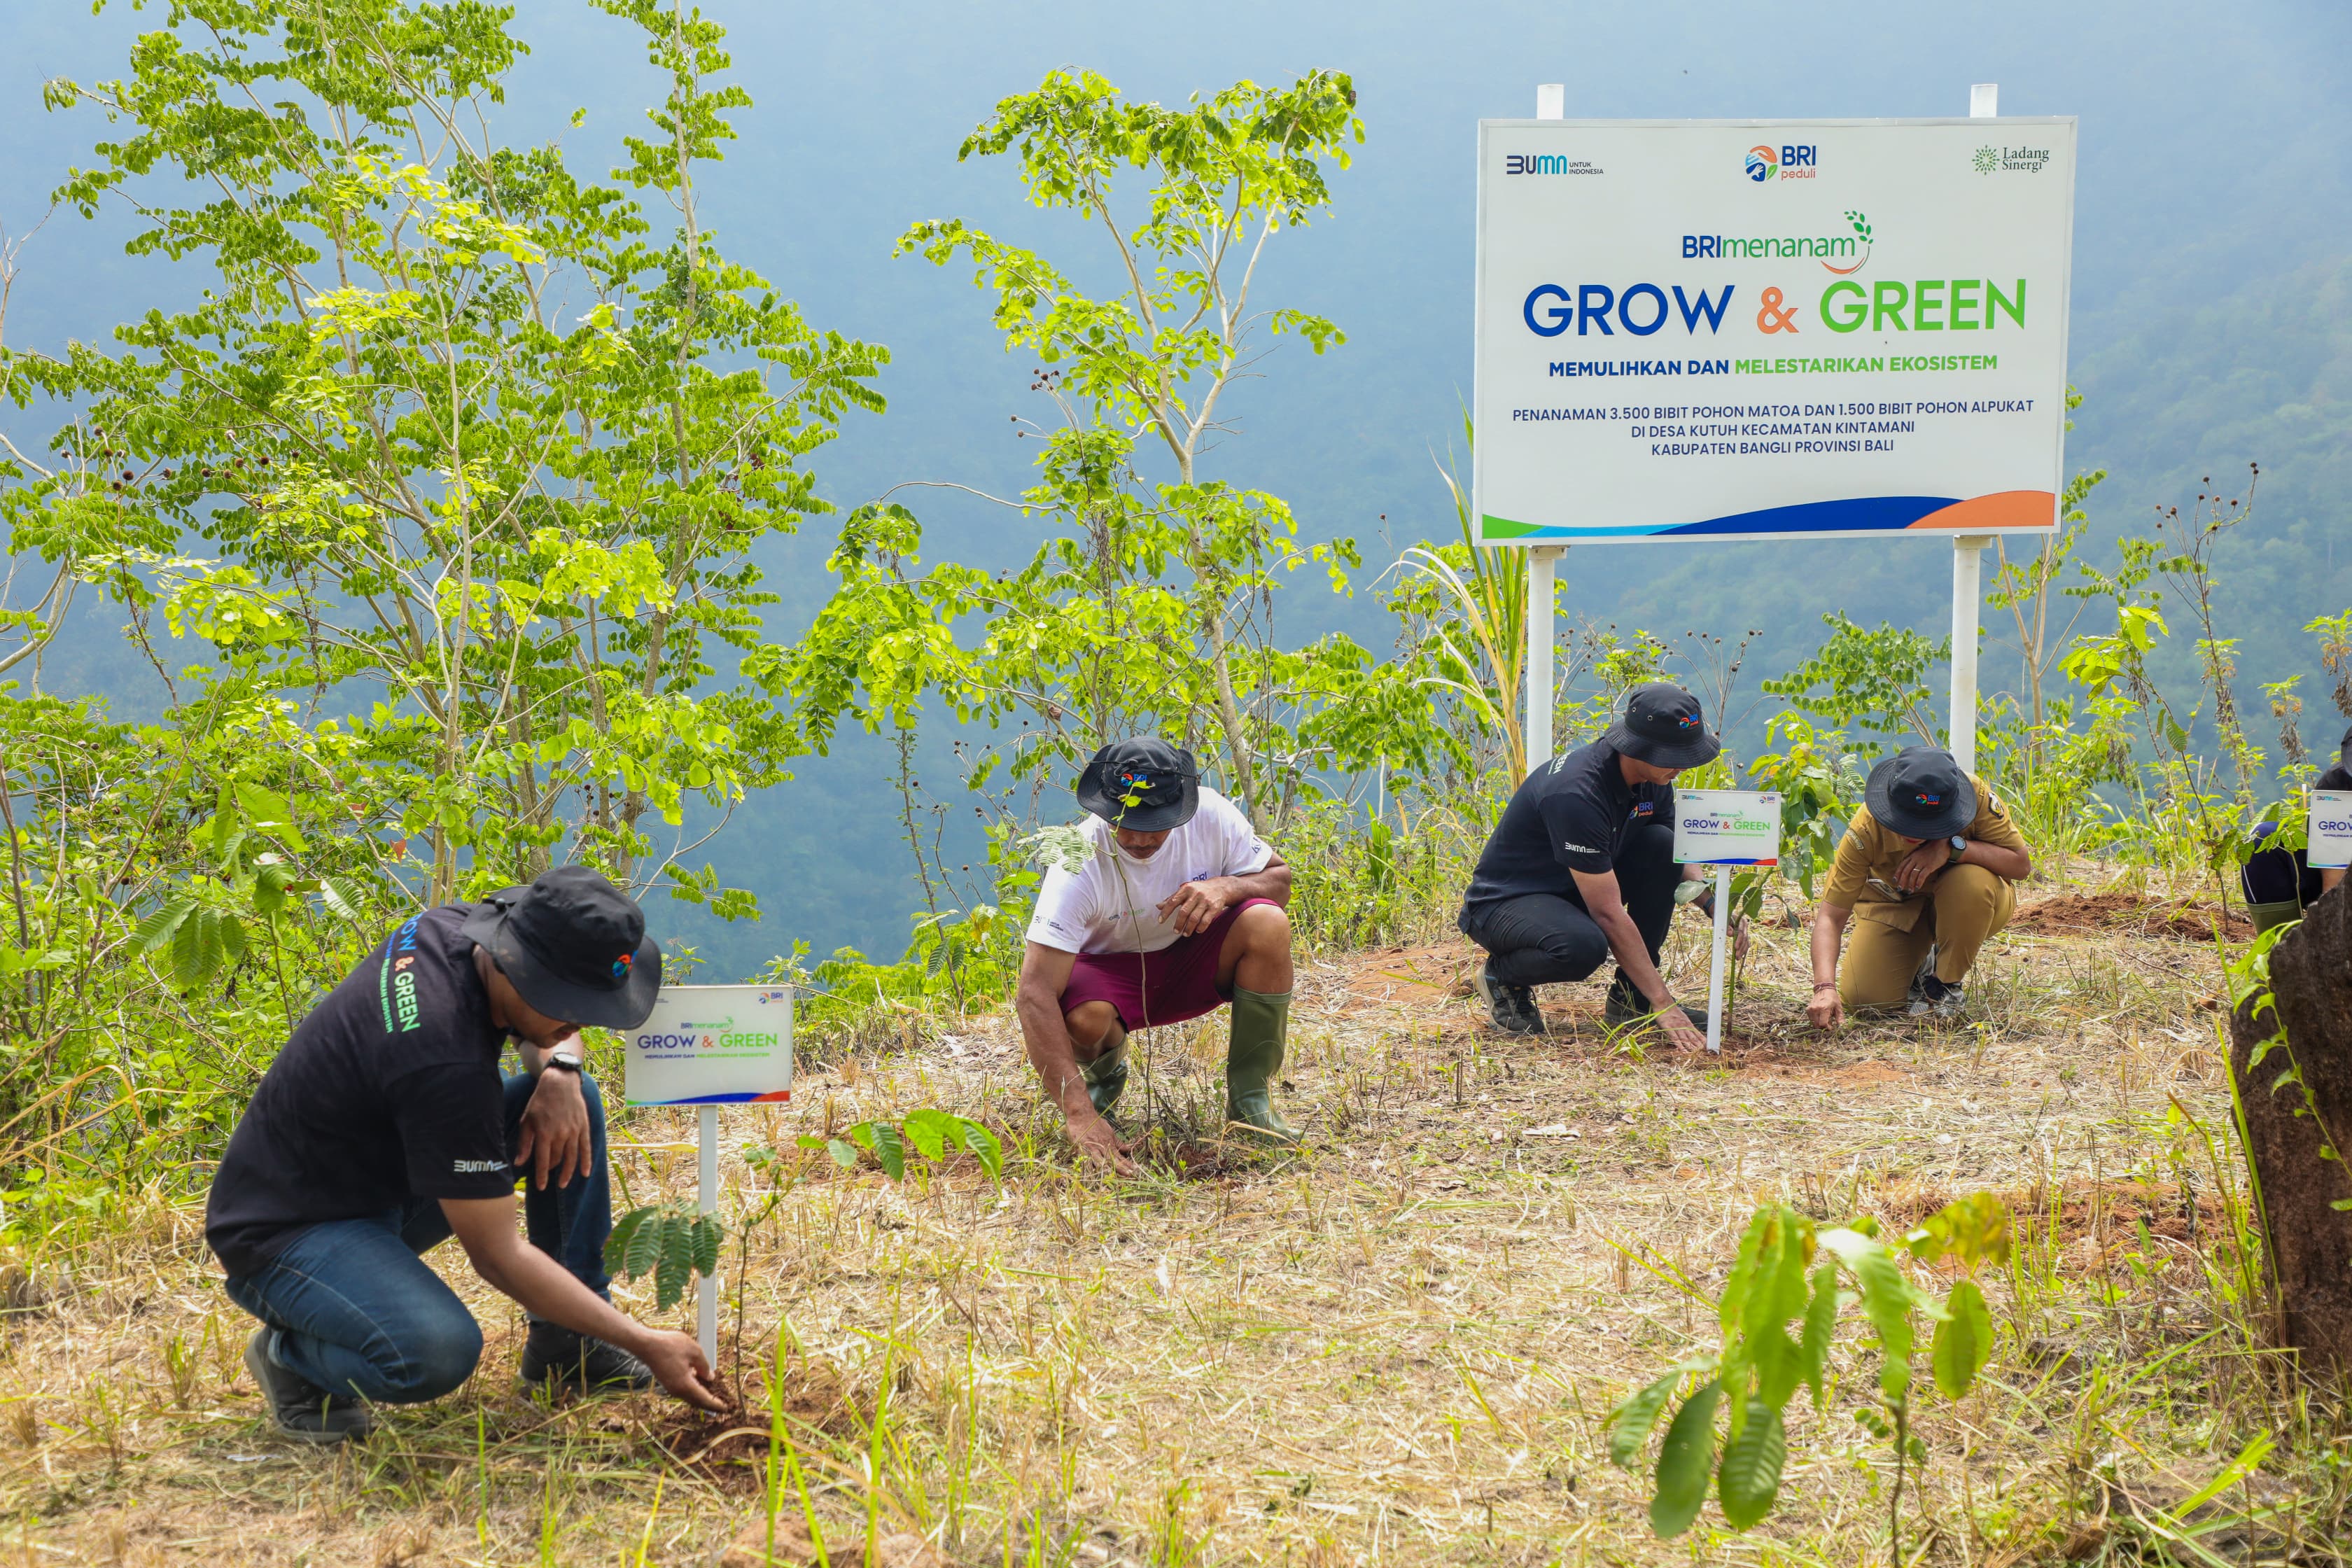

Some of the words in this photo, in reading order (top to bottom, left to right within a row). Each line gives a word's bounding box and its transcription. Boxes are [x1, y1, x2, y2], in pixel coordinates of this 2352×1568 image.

[1782, 146, 1816, 166] BRI
[2003, 146, 2050, 161] Ladang
[1506, 155, 1567, 174] BUMN
[2003, 160, 2045, 173] Sinergi
[1782, 168, 1815, 181] peduli
[1683, 235, 1854, 258] BRImenanam
[1524, 284, 1735, 337] GROW
[1757, 287, 1798, 334] &
[1820, 279, 2026, 333] GREEN
[1550, 360, 1681, 377] MEMULIHKAN
[1688, 360, 1728, 374] DAN
[1735, 358, 1883, 374] MELESTARIKAN
[1890, 356, 1997, 371] EKOSISTEM
[1513, 409, 1605, 421] PENANAMAN
[1611, 407, 1649, 419] 3.500
[1655, 407, 1688, 419] BIBIT
[1693, 407, 1744, 418] POHON
[1749, 405, 1800, 416] MATOA
[1805, 405, 1834, 416] DAN
[1839, 403, 1874, 415] 1.500
[1879, 403, 1912, 414] BIBIT
[1917, 402, 1967, 414] POHON
[1971, 400, 2033, 412] ALPUKAT
[1632, 426, 1644, 438] DI
[1650, 426, 1686, 437] DESA
[1690, 425, 1737, 436] KUTUH
[1742, 423, 1830, 435] KECAMATAN
[1836, 421, 1914, 433] KINTAMANI
[1653, 443, 1735, 455] KABUPATEN
[1741, 442, 1790, 454] BANGLI
[1795, 440, 1860, 452] PROVINSI
[1865, 440, 1893, 451] BALI
[1639, 802, 1653, 811] BRI
[1684, 819, 1719, 828] GROW
[1734, 821, 1770, 830] GREEN
[1564, 841, 1586, 853] BUMN
[394, 956, 414, 972] &
[394, 972, 421, 1032] GREEN
[638, 1035, 695, 1049] GROW
[702, 1036, 713, 1047] &
[719, 1033, 778, 1048] GREEN
[454, 1160, 493, 1172] BUMN
